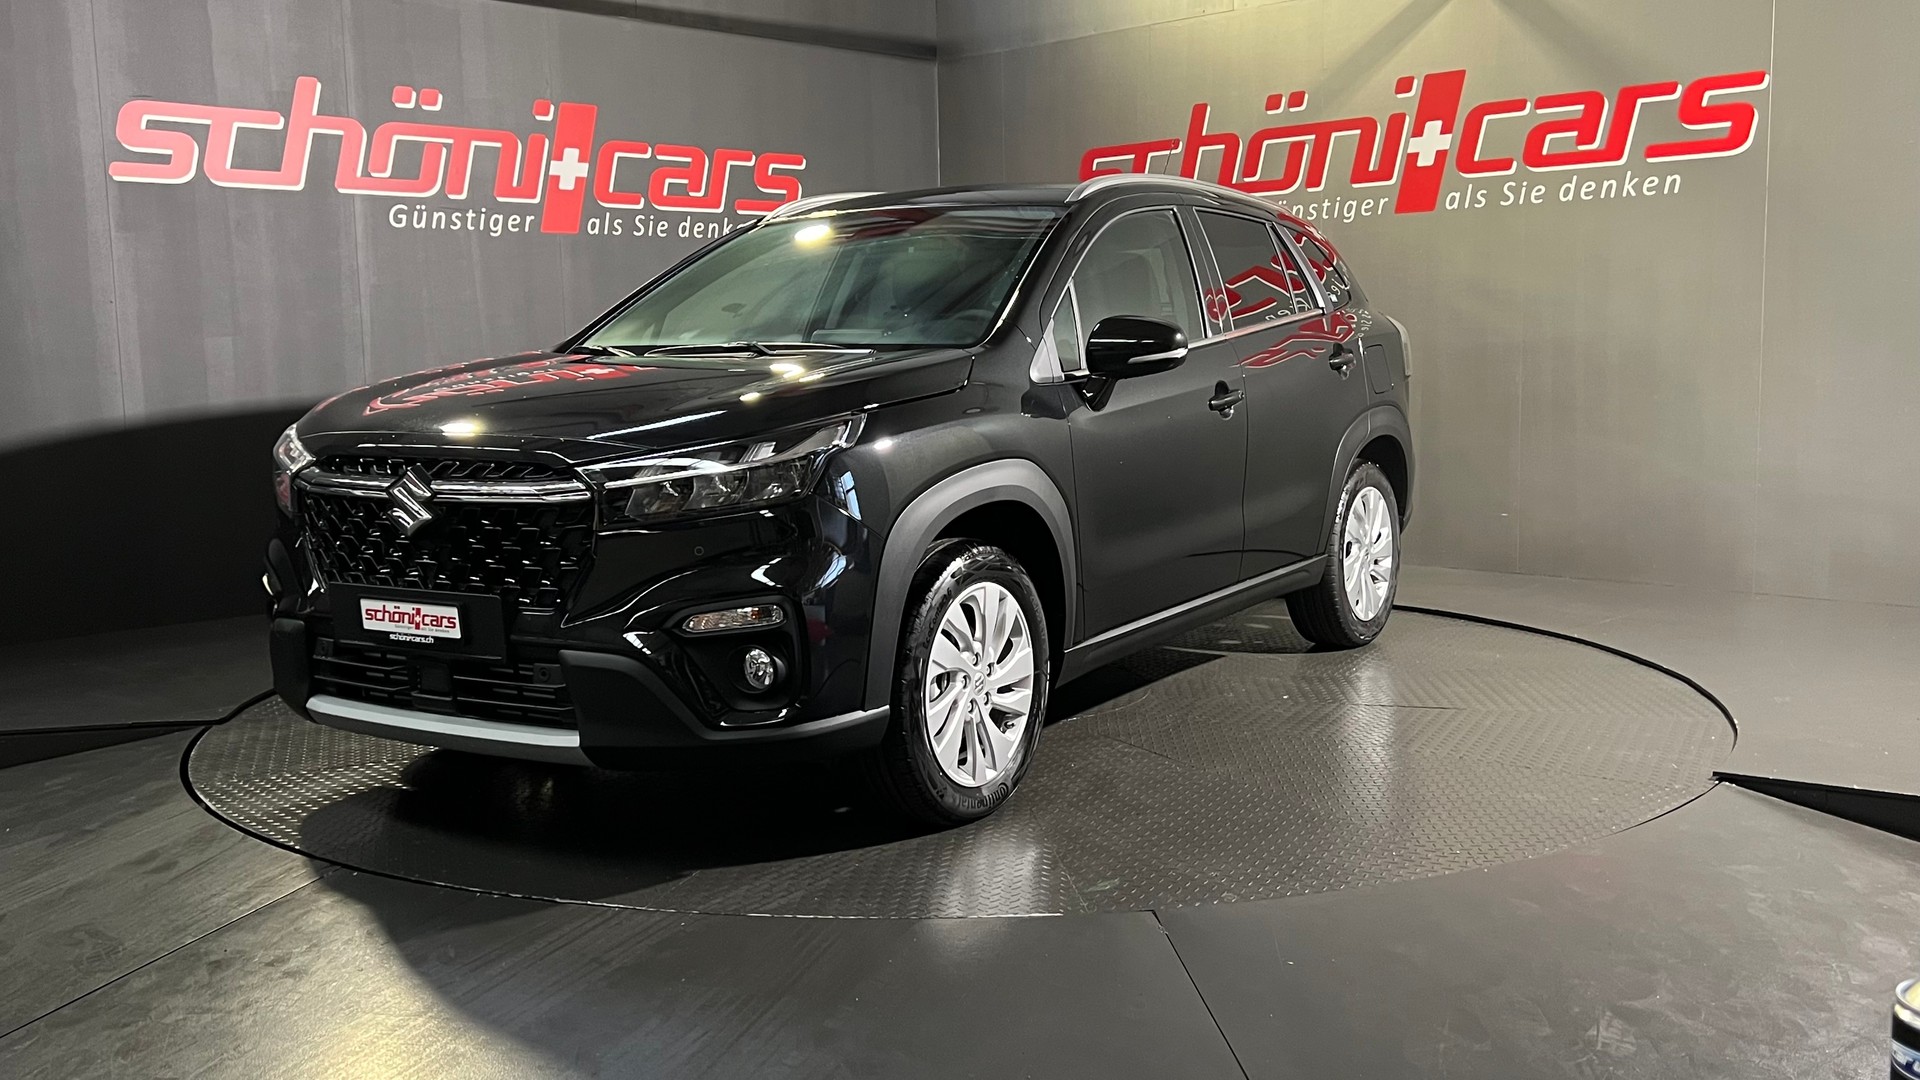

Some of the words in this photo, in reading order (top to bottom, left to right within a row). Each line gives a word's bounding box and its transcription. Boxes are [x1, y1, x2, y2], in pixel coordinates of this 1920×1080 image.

[1455, 70, 1770, 177] cars
[594, 140, 807, 214] cars
[1278, 196, 1389, 223] nstiger
[1445, 183, 1488, 210] als
[1499, 179, 1546, 206] Sie
[1558, 172, 1682, 202] denken
[388, 203, 535, 237] Günstiger
[587, 211, 623, 236] als
[632, 214, 668, 237] Sie
[678, 215, 757, 239] denk
[421, 613, 457, 629] cars
